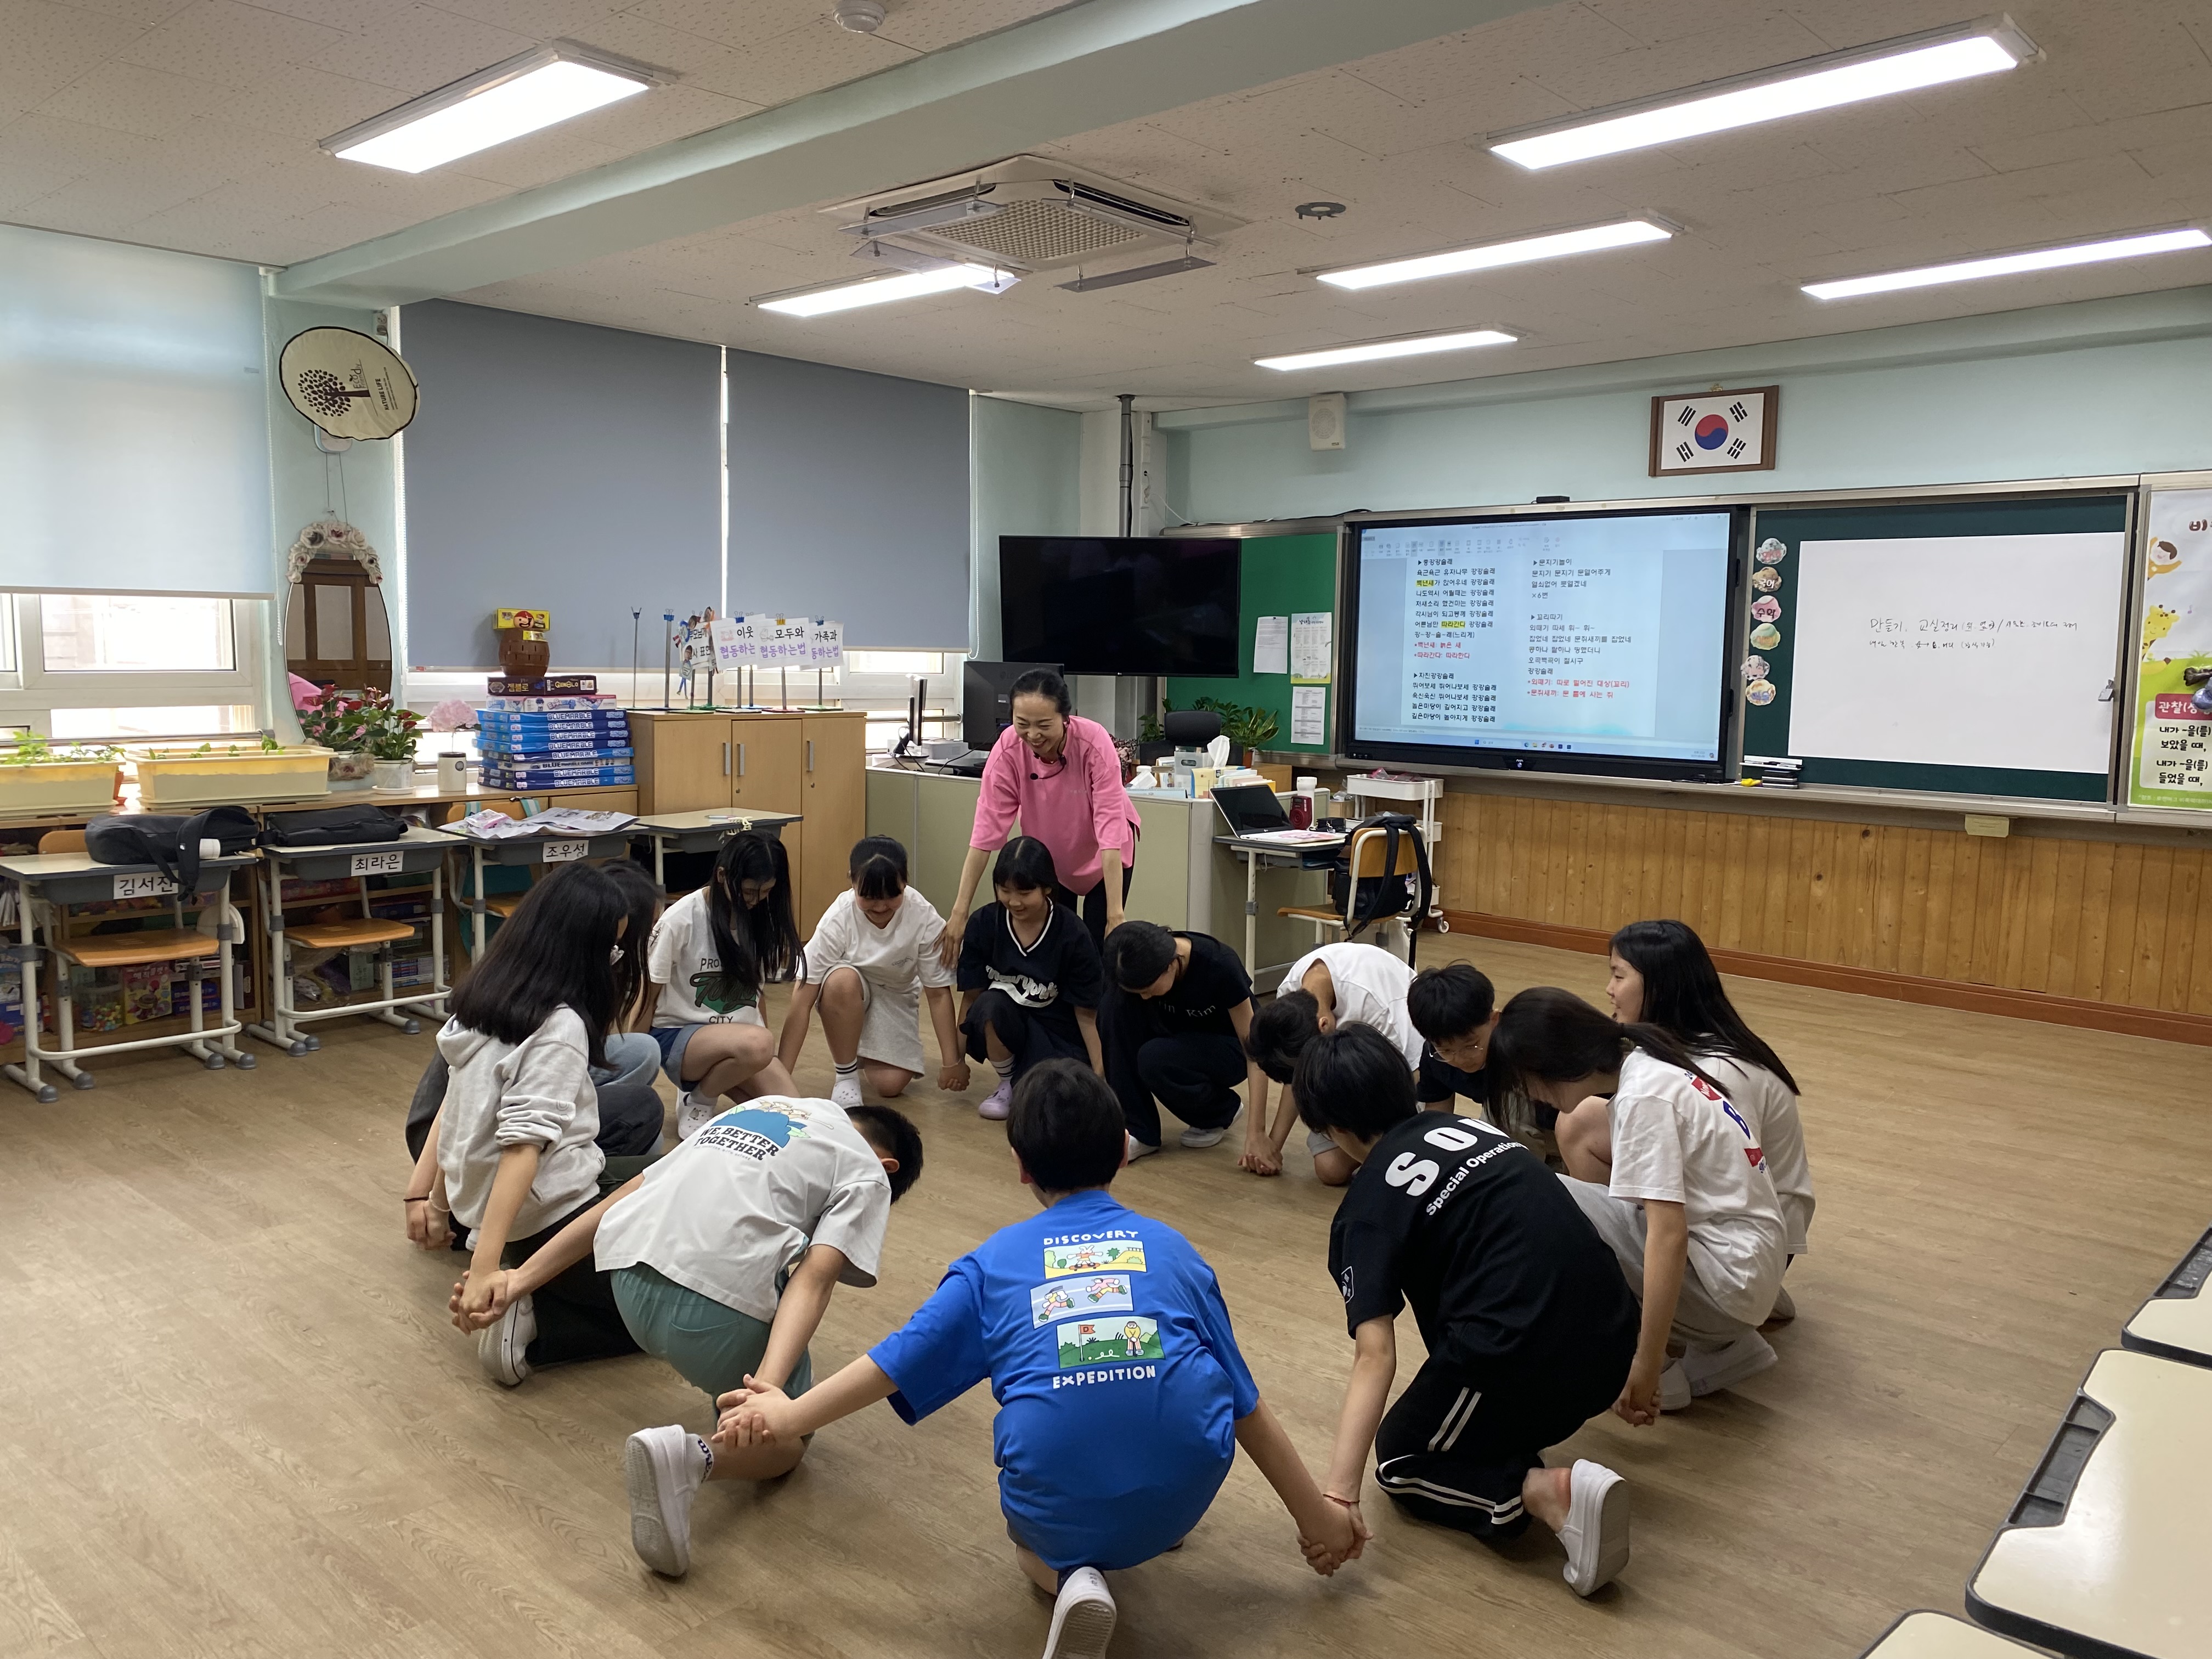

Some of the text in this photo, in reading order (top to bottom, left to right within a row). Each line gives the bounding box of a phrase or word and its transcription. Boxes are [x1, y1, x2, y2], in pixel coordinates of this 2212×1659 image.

[375, 378, 390, 410] NATURE LIFE
[1920, 619, 1958, 631] 교실정리
[775, 627, 805, 639] 모두와
[815, 630, 838, 642] 가족과
[760, 642, 806, 658] 협동하는법
[811, 645, 839, 659] 동하는법
[507, 682, 529, 692] 젬블로
[2161, 740, 2207, 752] 보았을 때,
[555, 778, 599, 787] BLUEMARBLE
[2159, 772, 2203, 786] 들었을 때,
[546, 843, 585, 857] 조우성
[354, 853, 400, 871] 최라은
[700, 958, 722, 970] PRO
[1185, 1005, 1216, 1017] Kim
[693, 1136, 766, 1161] TOGETHER
[721, 1127, 779, 1156] BETTER
[1426, 1166, 1470, 1216] Special
[1043, 1230, 1138, 1245] DISCOVERY
[1053, 1365, 1156, 1389] EXPEDITION
